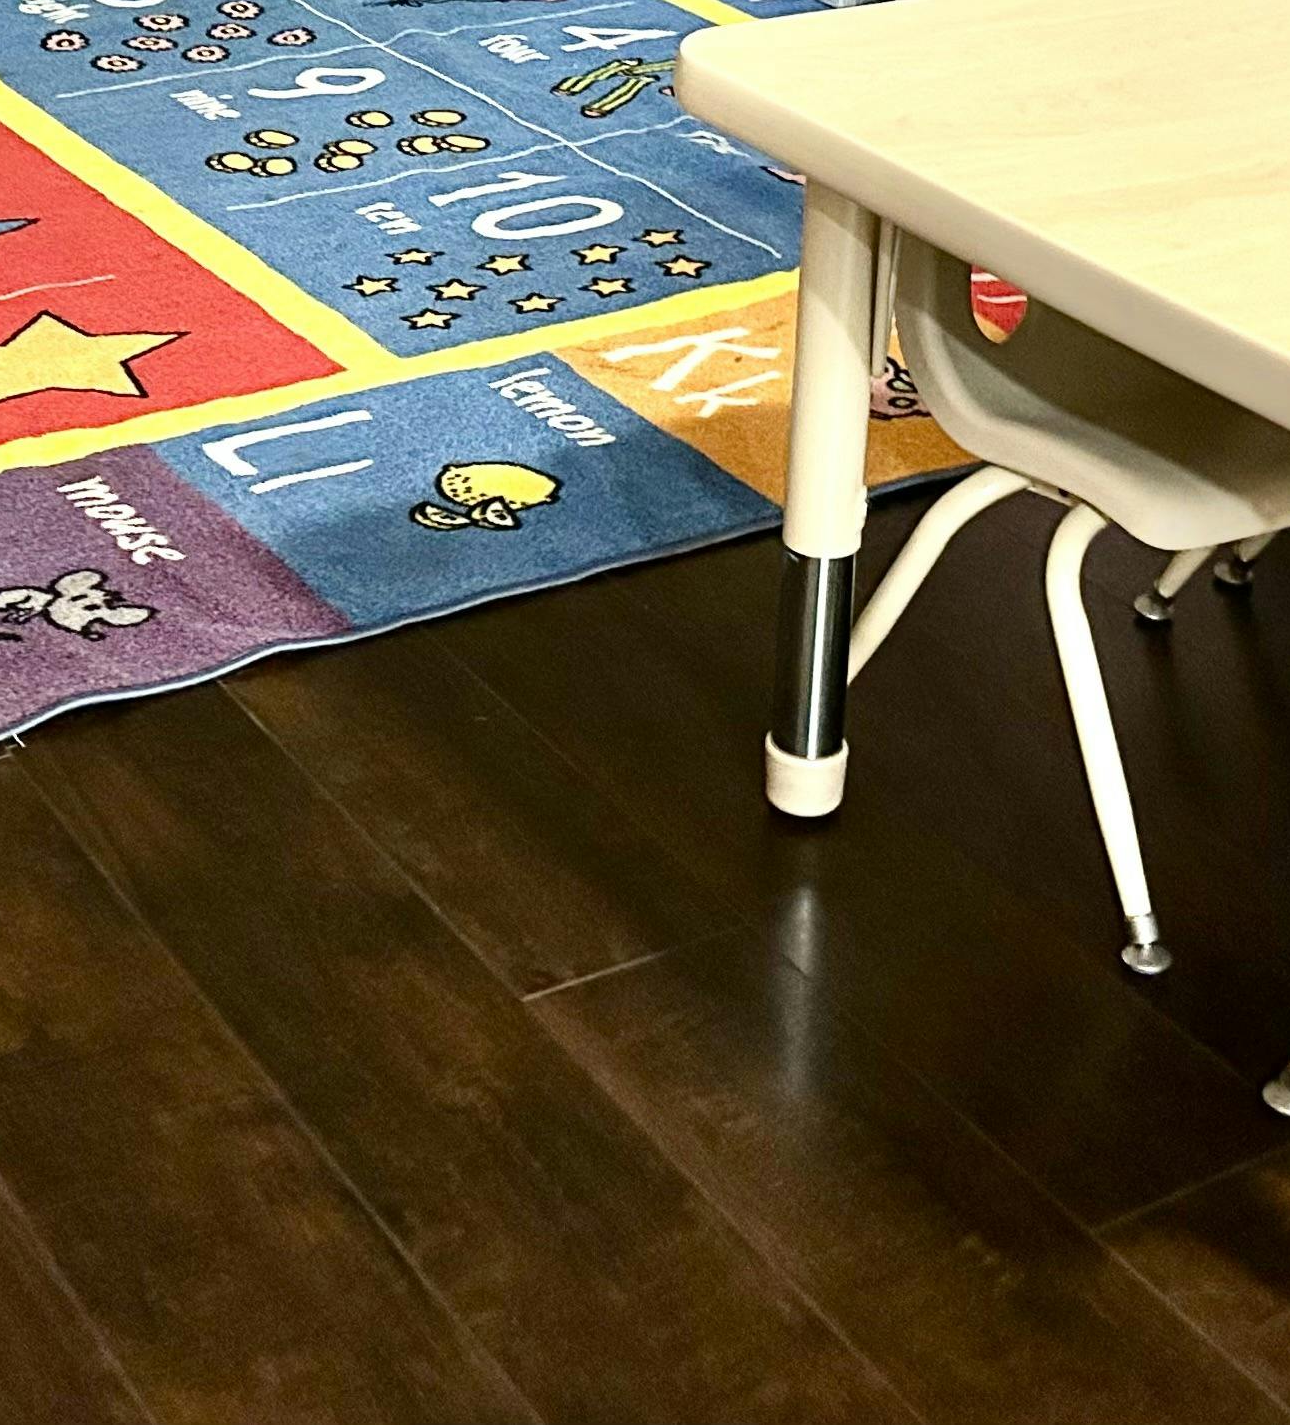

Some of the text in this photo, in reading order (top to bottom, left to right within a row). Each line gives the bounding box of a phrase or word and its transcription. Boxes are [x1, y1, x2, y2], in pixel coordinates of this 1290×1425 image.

[478, 34, 550, 64] four
[560, 25, 682, 54] 4
[169, 89, 242, 121] nine
[247, 66, 387, 100] 9
[355, 201, 423, 236] ten
[427, 170, 626, 241] 10
[601, 326, 784, 419] Kk
[487, 366, 617, 448] lemon
[202, 410, 374, 495] Ll
[57, 475, 187, 566] mouse
